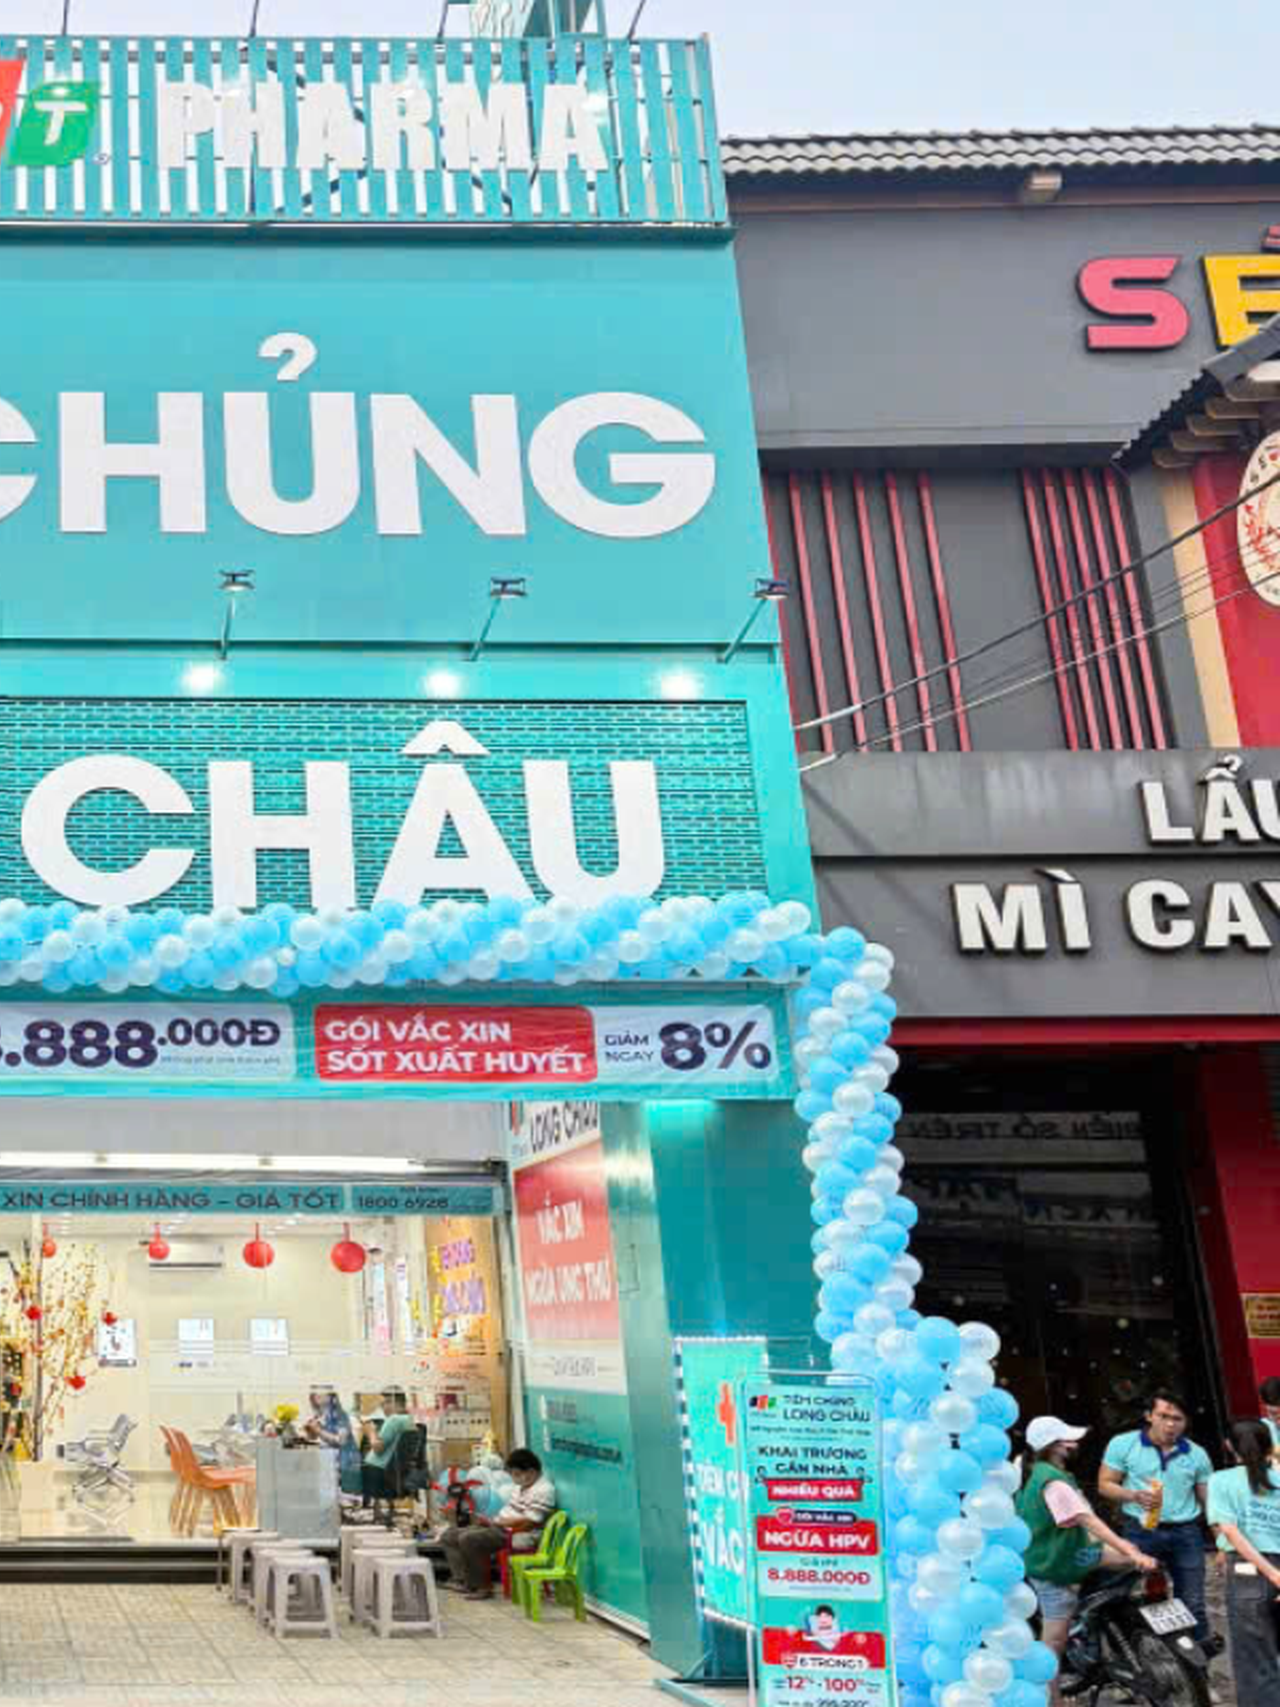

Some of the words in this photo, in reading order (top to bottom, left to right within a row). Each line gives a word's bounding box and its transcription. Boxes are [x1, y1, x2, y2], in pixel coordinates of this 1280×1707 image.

[157, 80, 609, 171] PHARMA
[21, 720, 666, 910] CHÂU
[951, 868, 1092, 953] MÌ
[325, 1017, 381, 1042] GÓI
[390, 1013, 457, 1042] VẮC
[460, 1020, 511, 1041] XIN
[327, 1046, 388, 1073] SỐT
[394, 1047, 477, 1074] XUẤT
[483, 1045, 587, 1074] HUYẾT
[604, 1030, 650, 1047] GIẢM
[658, 1021, 771, 1071] 8%
[605, 1051, 654, 1063] NGAY
[2, 1191, 45, 1209] XIN
[47, 1188, 129, 1209] CHÍNH
[134, 1188, 212, 1210] HÀNG
[242, 1189, 299, 1210] GIÁ
[302, 1187, 341, 1210] TỐT
[828, 1533, 871, 1549] HPV
